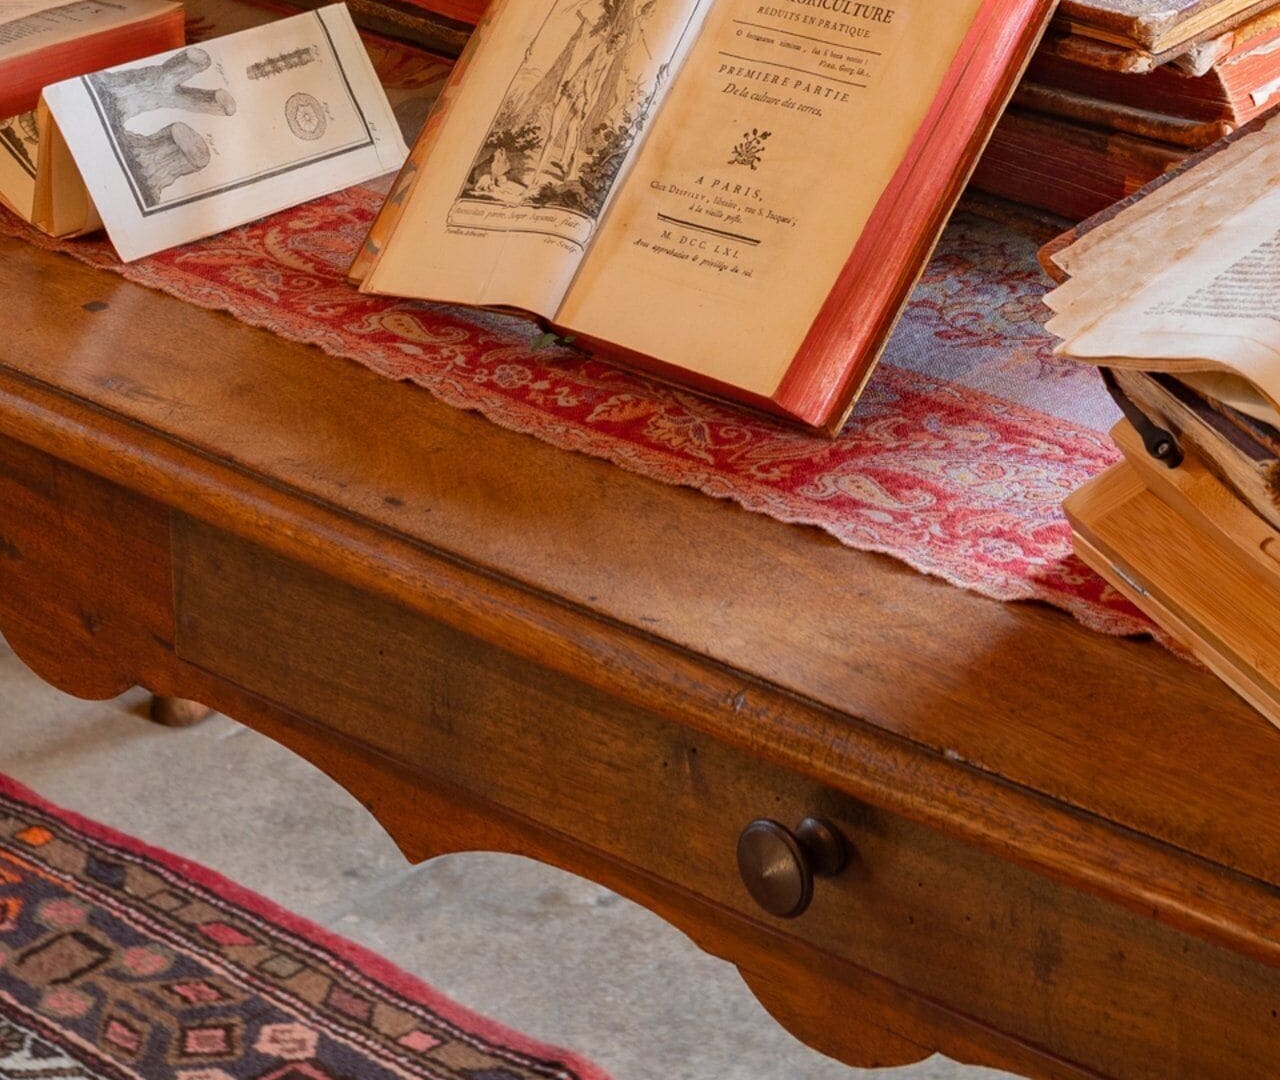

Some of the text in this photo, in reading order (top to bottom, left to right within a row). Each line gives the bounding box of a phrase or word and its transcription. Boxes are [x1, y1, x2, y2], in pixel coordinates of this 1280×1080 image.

[719, 64, 790, 87] PREMIERE
[750, 90, 781, 106] culture
[781, 96, 795, 109] des
[711, 180, 763, 201] PARIS,
